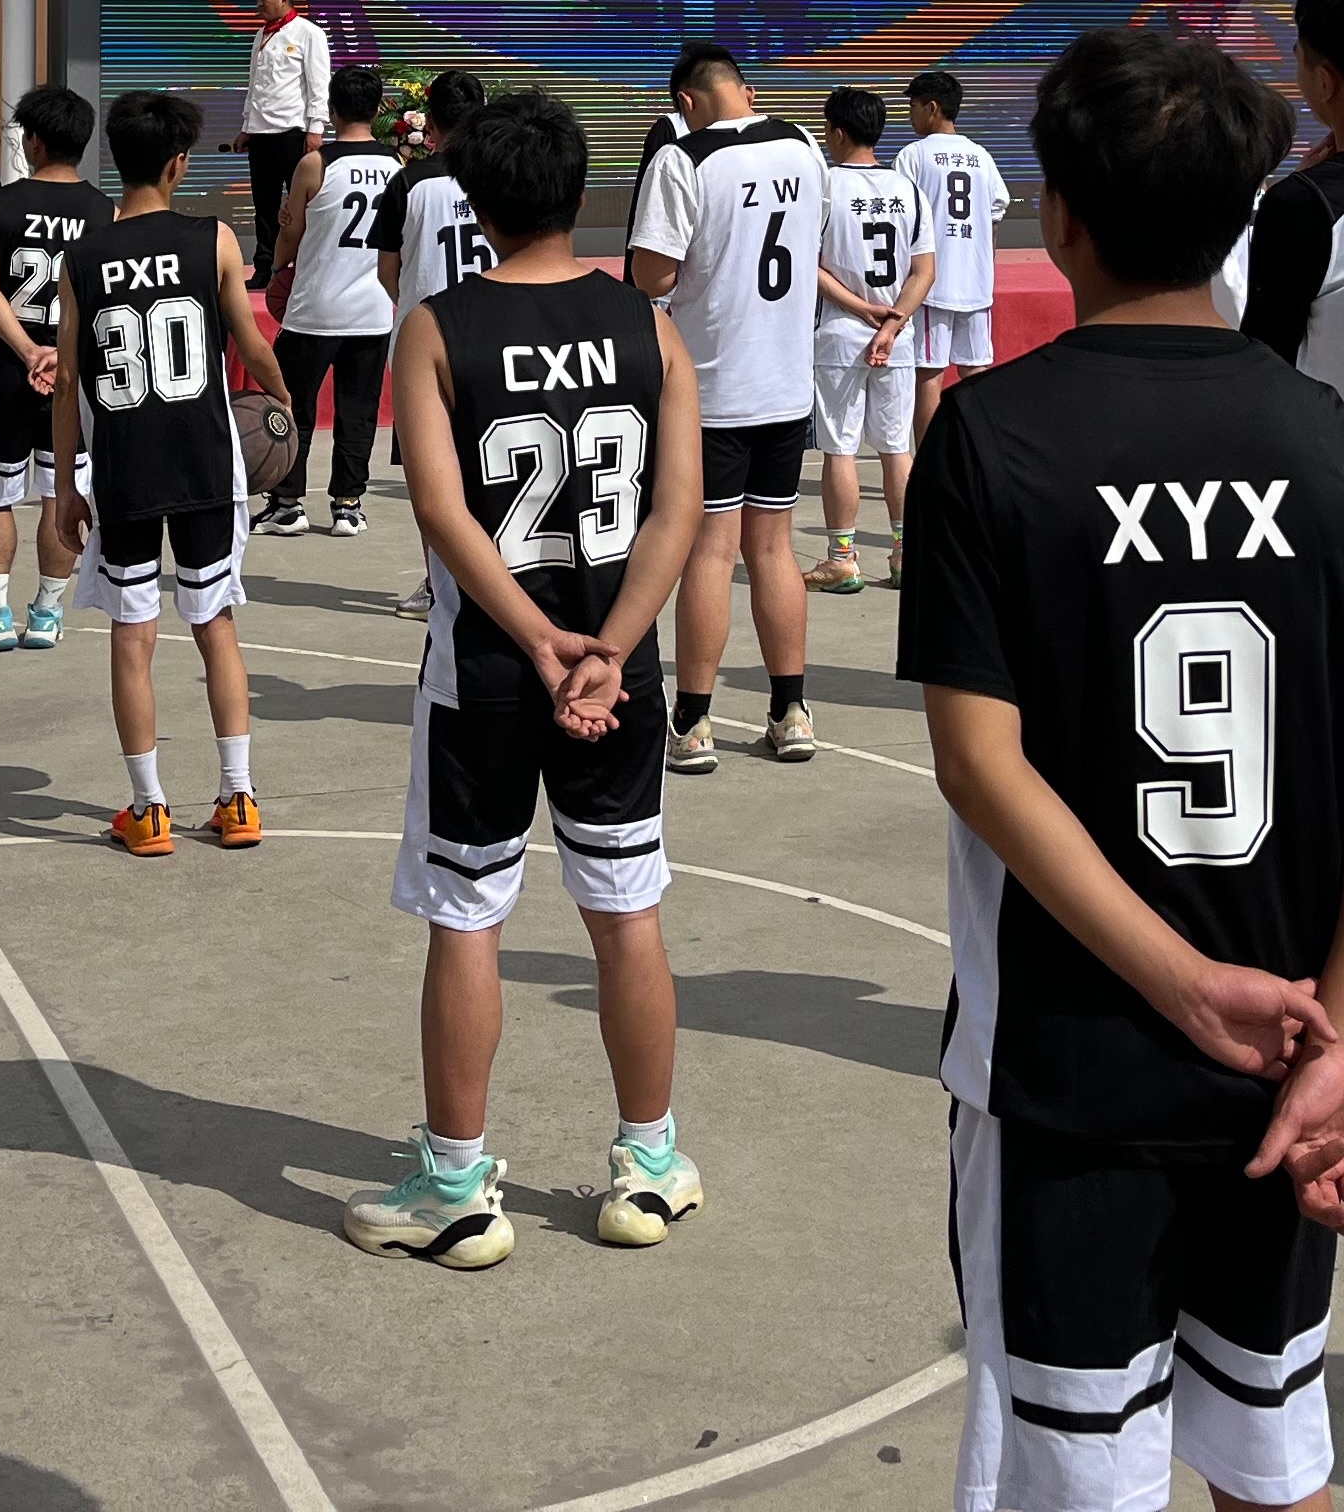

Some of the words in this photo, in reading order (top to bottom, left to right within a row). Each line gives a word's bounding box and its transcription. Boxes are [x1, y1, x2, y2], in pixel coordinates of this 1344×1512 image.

[350, 168, 391, 186] DHY
[933, 152, 981, 169] 研学班
[850, 196, 906, 216] 李豪杰
[947, 170, 971, 221] 8
[24, 214, 86, 241] ZYW
[436, 223, 493, 289] 15
[757, 210, 792, 302] 6
[862, 221, 897, 288] 3
[101, 253, 181, 295] PXR
[92, 295, 208, 412] 30
[502, 337, 617, 393] CXN
[478, 403, 647, 574] 23
[1096, 479, 1296, 565] XYX
[1131, 600, 1277, 867] 9
